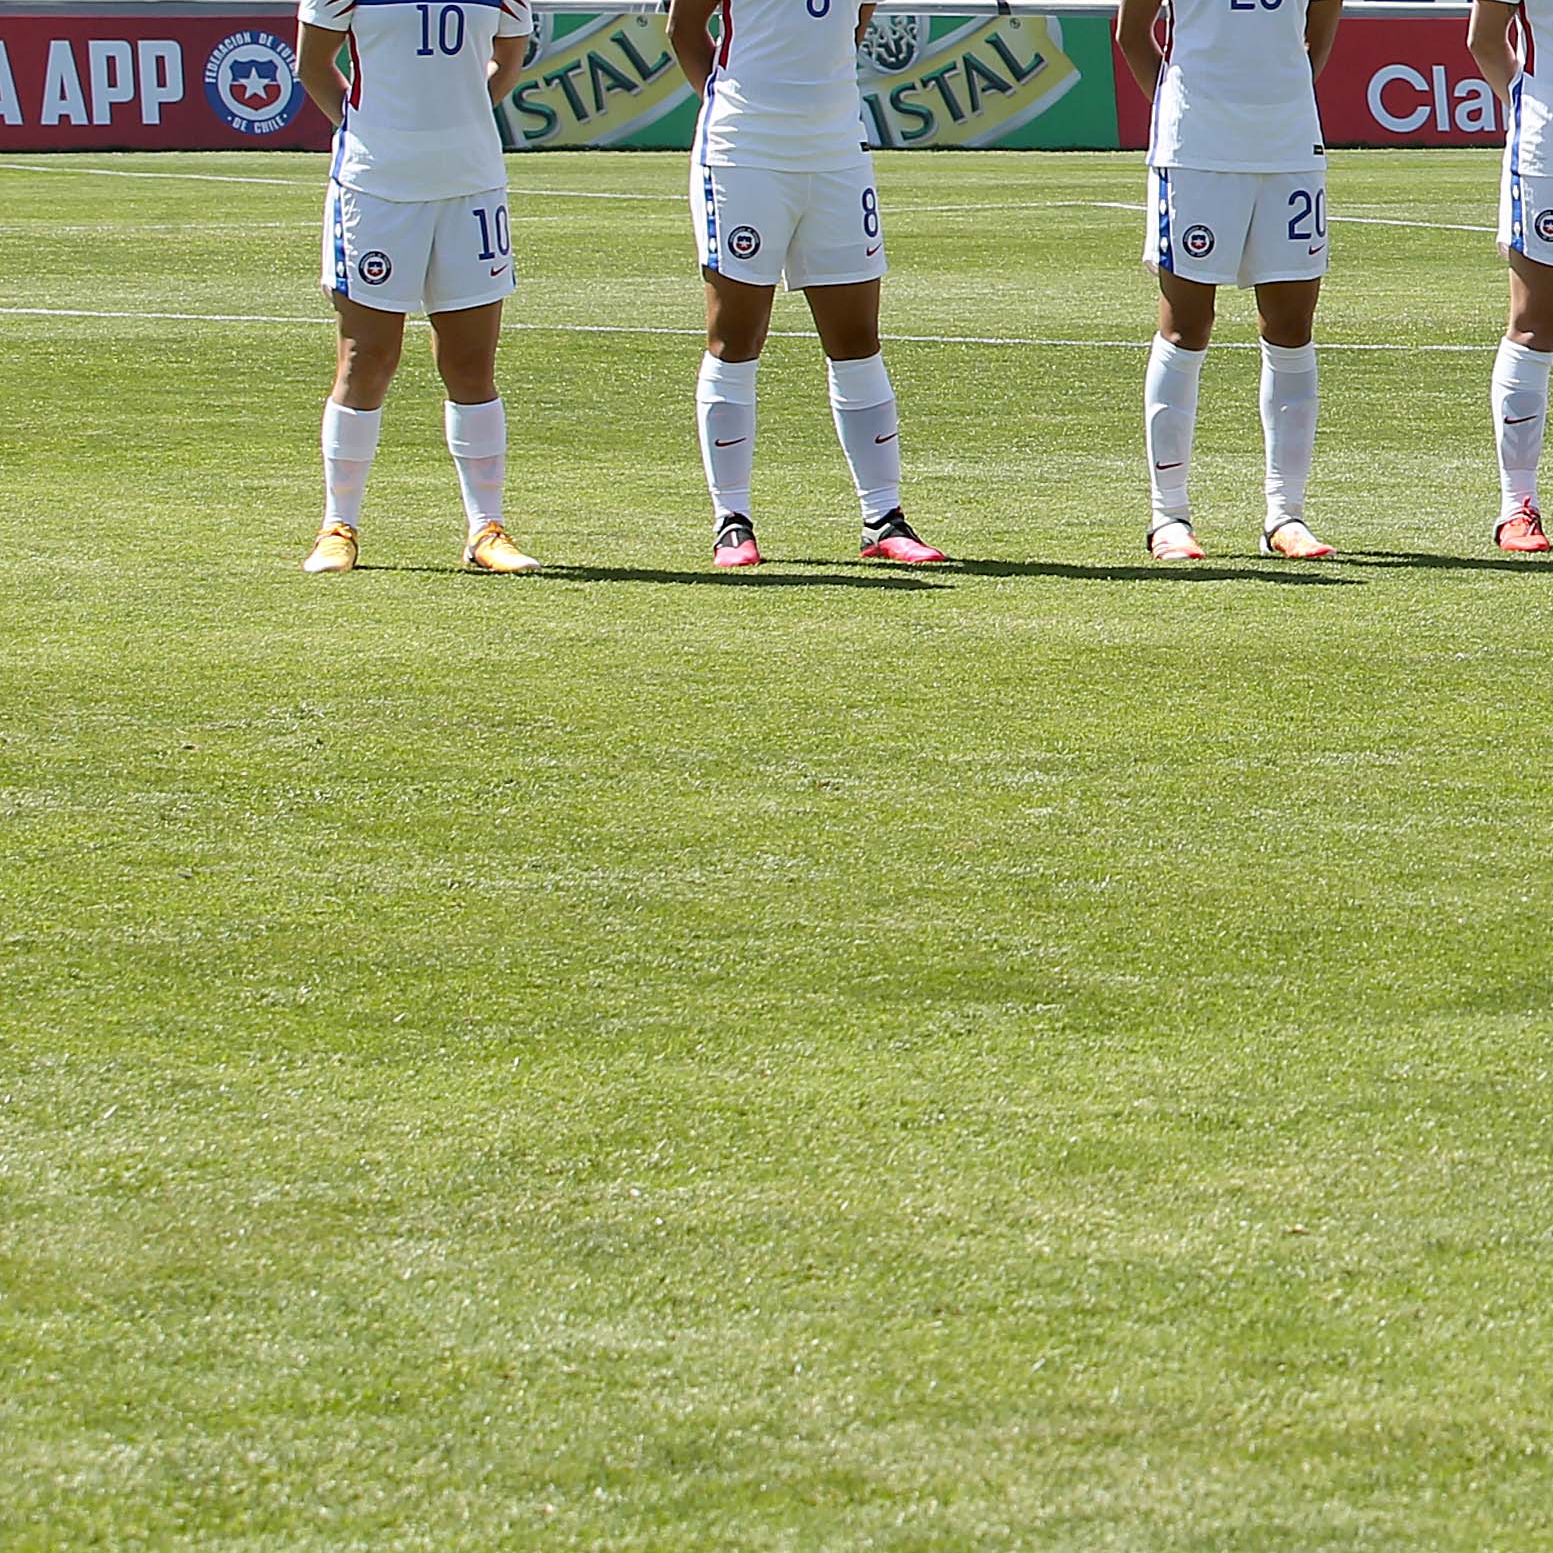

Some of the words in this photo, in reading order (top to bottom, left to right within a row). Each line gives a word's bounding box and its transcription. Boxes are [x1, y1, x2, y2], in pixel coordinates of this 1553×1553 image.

[416, 4, 464, 56] 10
[41, 39, 184, 125] APP
[1367, 64, 1510, 134] Cla
[232, 117, 248, 132] DE
[254, 115, 285, 134] CHILE
[472, 205, 510, 261] 10
[861, 188, 879, 238] 8
